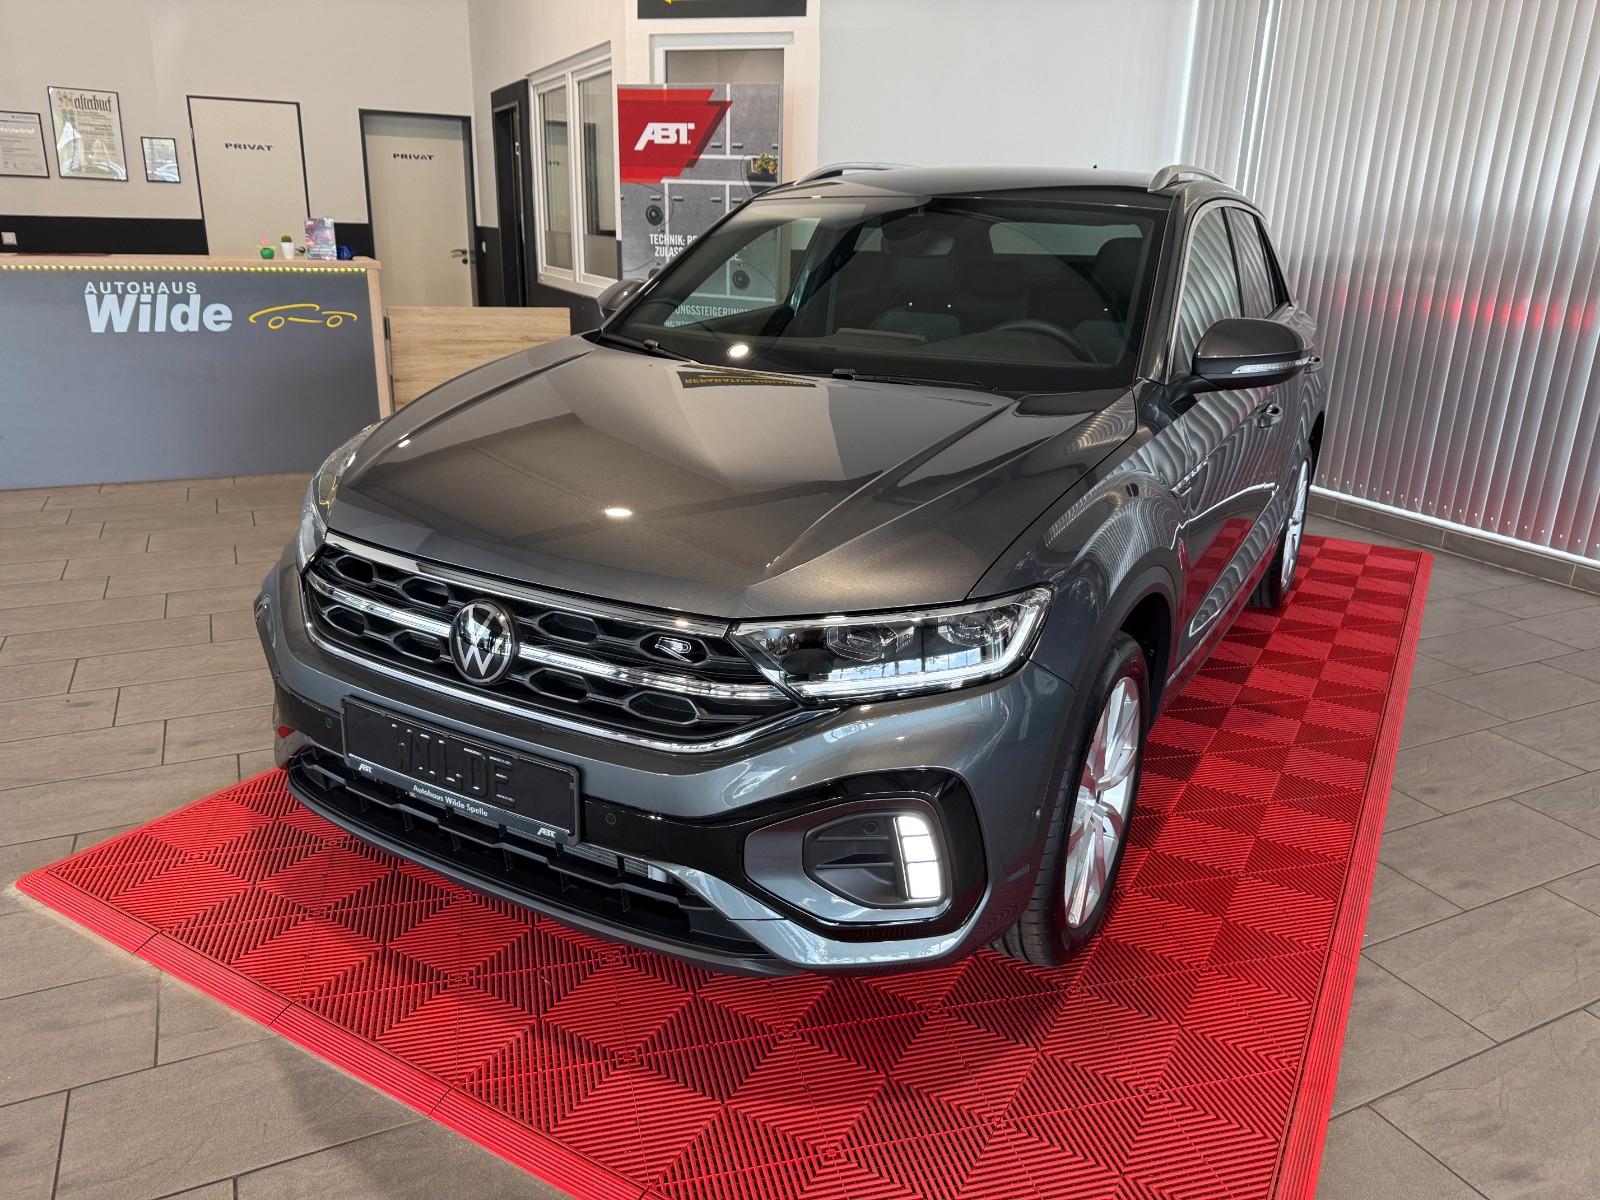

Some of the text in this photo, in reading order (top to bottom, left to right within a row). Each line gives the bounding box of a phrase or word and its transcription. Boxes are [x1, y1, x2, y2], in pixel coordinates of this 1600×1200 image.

[634, 122, 696, 151] ABT
[225, 142, 274, 151] PRIVAT
[392, 153, 434, 161] PRIVAT
[649, 233, 685, 246] TECHNIK:
[84, 281, 198, 294] AUTOHAUS
[84, 293, 233, 333] Wilde
[412, 784, 489, 818] Autohaus Wilde Spelle
[537, 827, 557, 839] ABT
